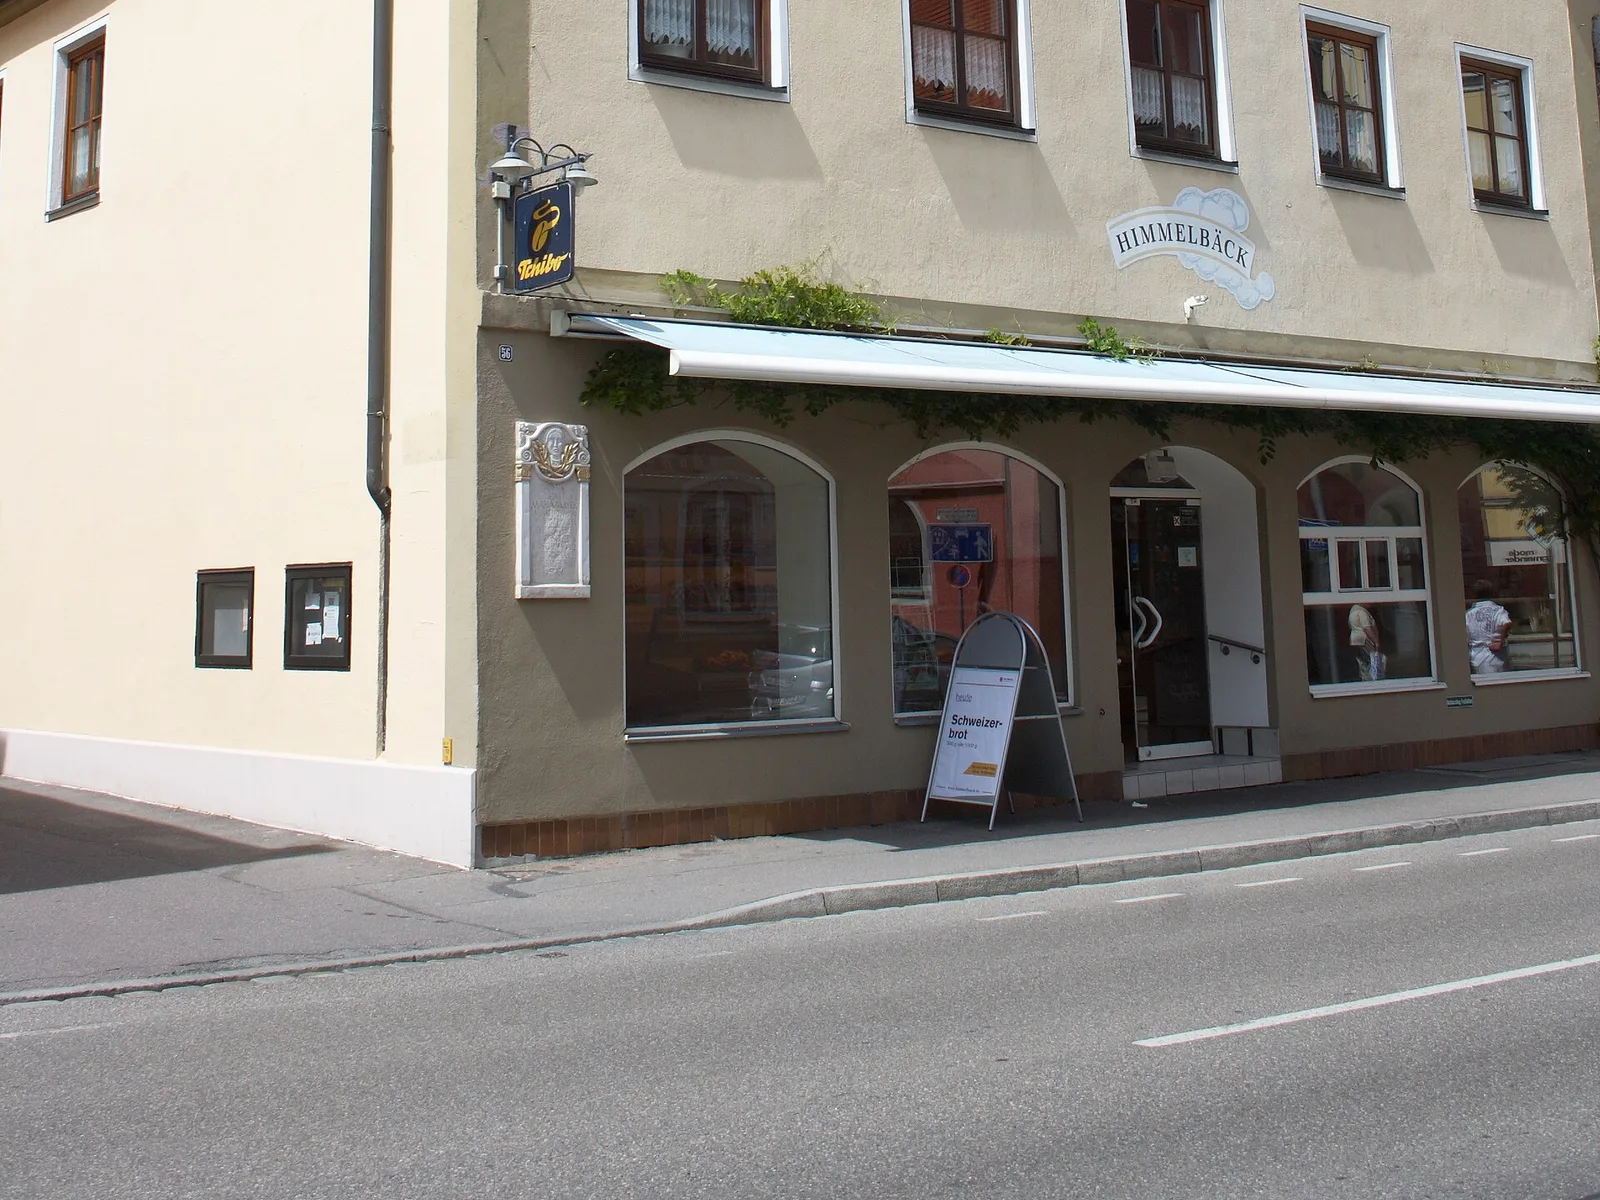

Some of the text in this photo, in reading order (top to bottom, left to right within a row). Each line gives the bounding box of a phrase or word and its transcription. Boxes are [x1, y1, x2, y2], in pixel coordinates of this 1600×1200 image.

[1116, 222, 1249, 268] HIMMELBÄCK
[518, 253, 568, 280] Tchibo
[501, 347, 511, 359] 56
[951, 714, 1003, 728] Schweizer-
[948, 728, 968, 739] brot
